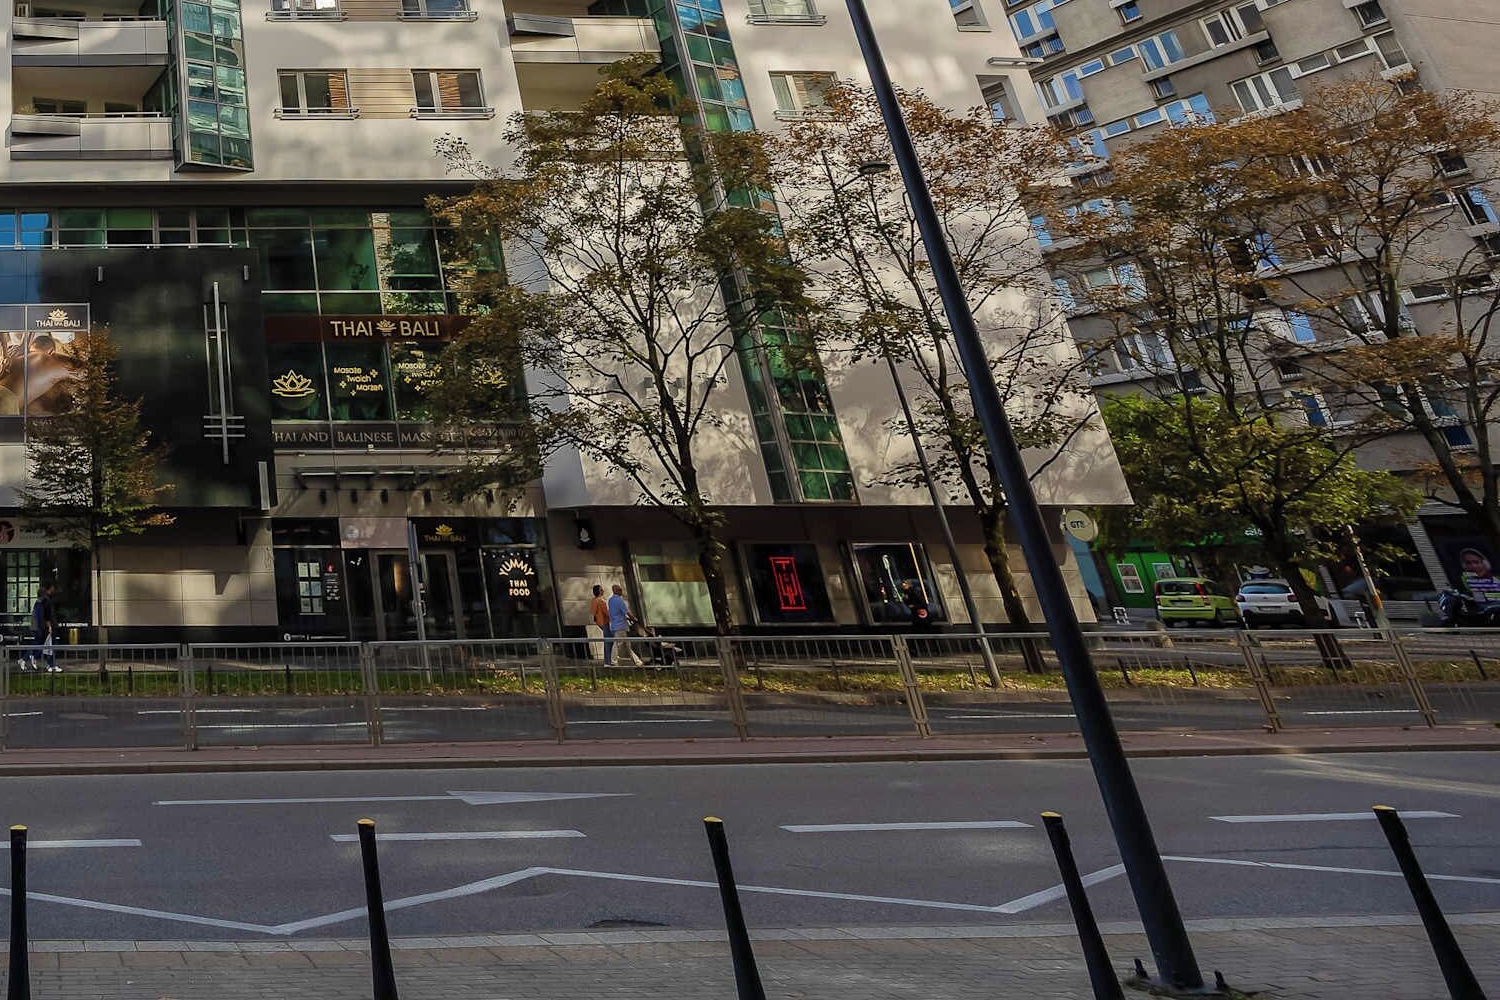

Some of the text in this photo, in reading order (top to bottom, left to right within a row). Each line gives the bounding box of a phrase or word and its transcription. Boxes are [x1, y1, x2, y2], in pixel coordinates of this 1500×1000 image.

[330, 321, 440, 337] THAI BALI
[272, 431, 297, 442] HAI
[300, 431, 329, 442] AND
[337, 431, 394, 442] BALINESE
[499, 558, 535, 576] YUMMY
[509, 579, 528, 588] THAI
[508, 587, 530, 597] FOOD
